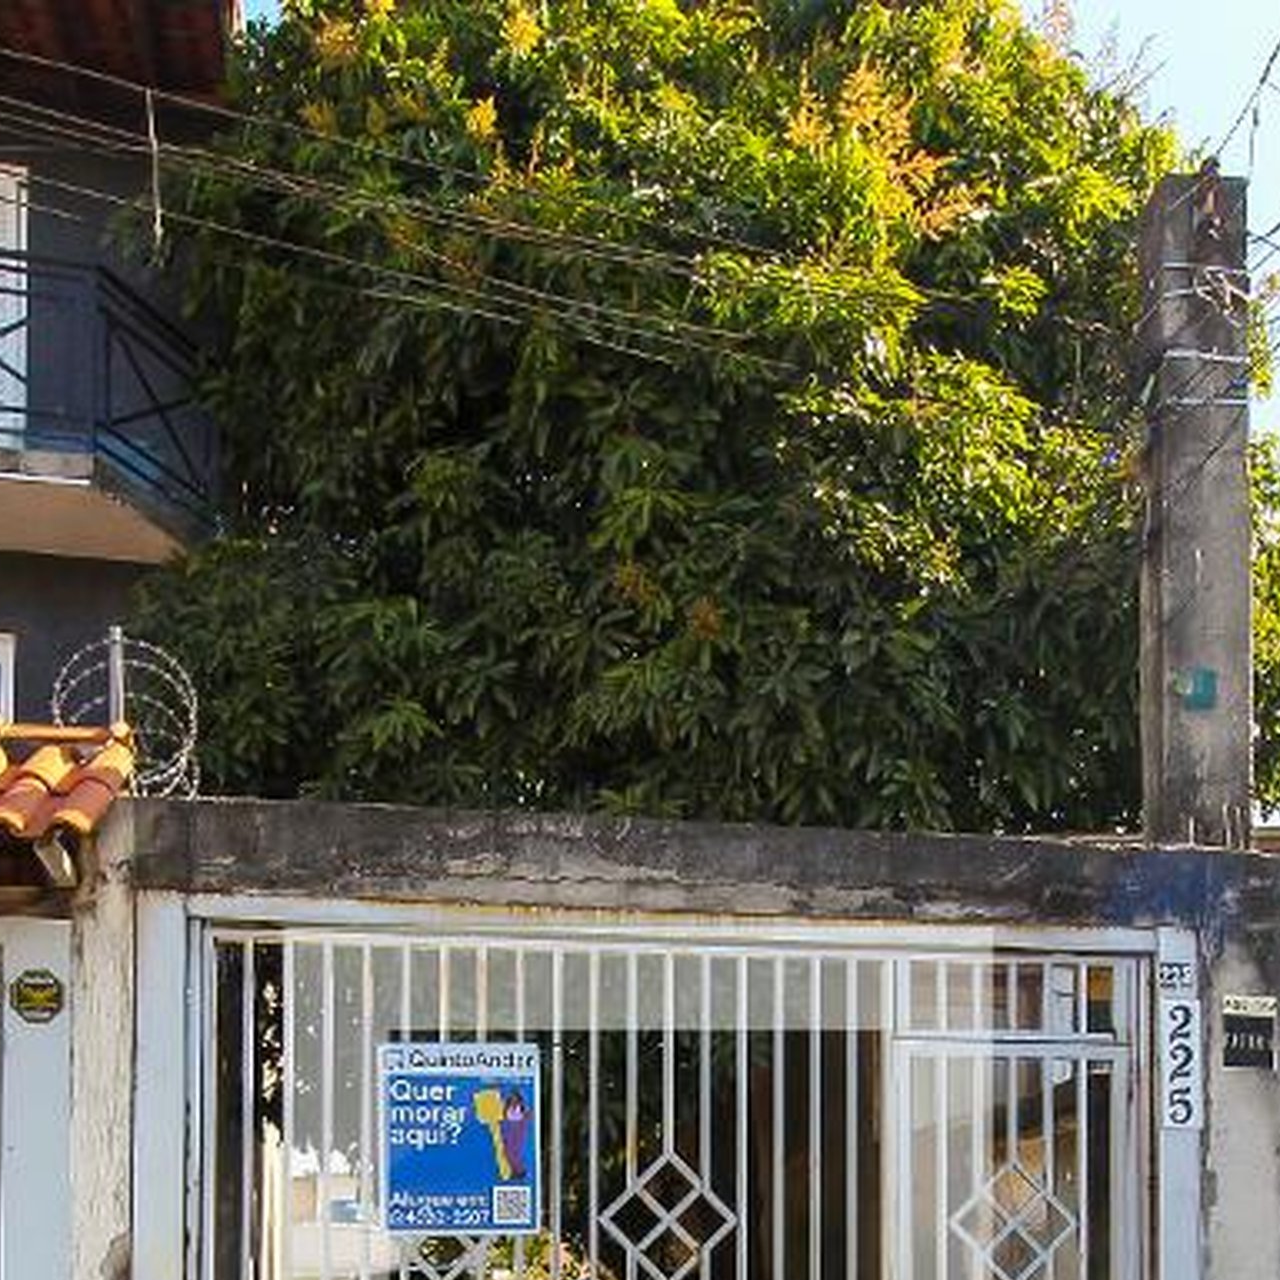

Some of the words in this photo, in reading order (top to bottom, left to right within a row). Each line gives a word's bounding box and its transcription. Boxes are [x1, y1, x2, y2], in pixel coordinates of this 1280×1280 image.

[1168, 1004, 1194, 1125] 225
[391, 1078, 456, 1102] Quer
[391, 1105, 467, 1123] morar
[391, 1124, 463, 1149] aqui?
